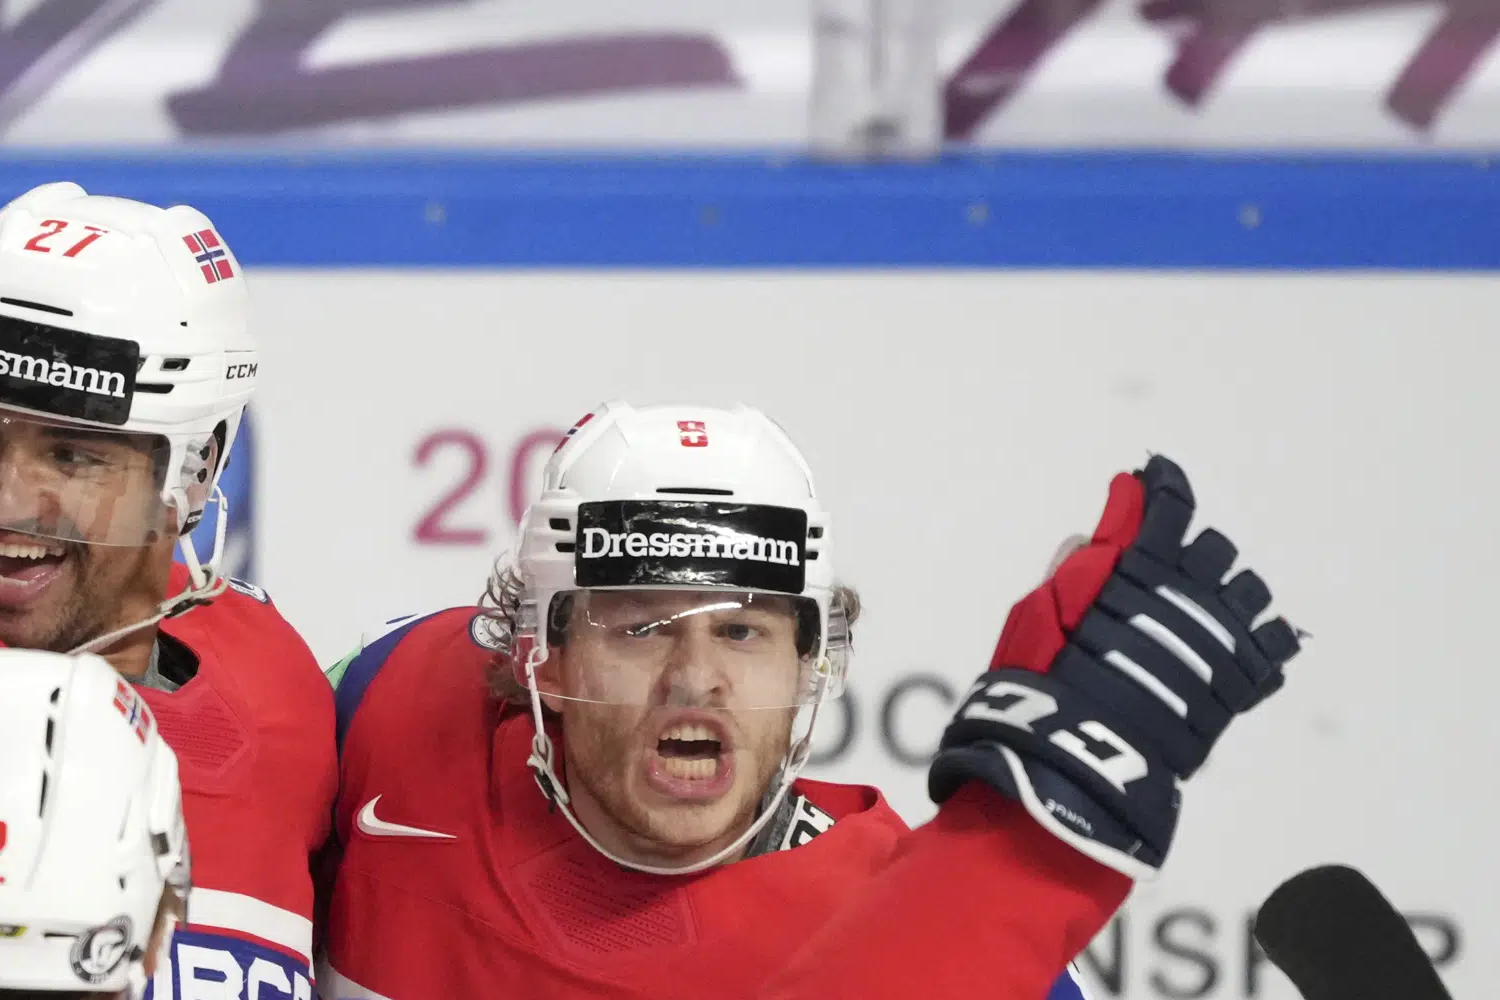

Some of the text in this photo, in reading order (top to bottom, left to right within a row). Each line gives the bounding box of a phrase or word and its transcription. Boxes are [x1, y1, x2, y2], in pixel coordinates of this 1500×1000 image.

[22, 219, 110, 258] 27
[225, 362, 259, 381] CCM
[581, 527, 801, 567] Dressmann
